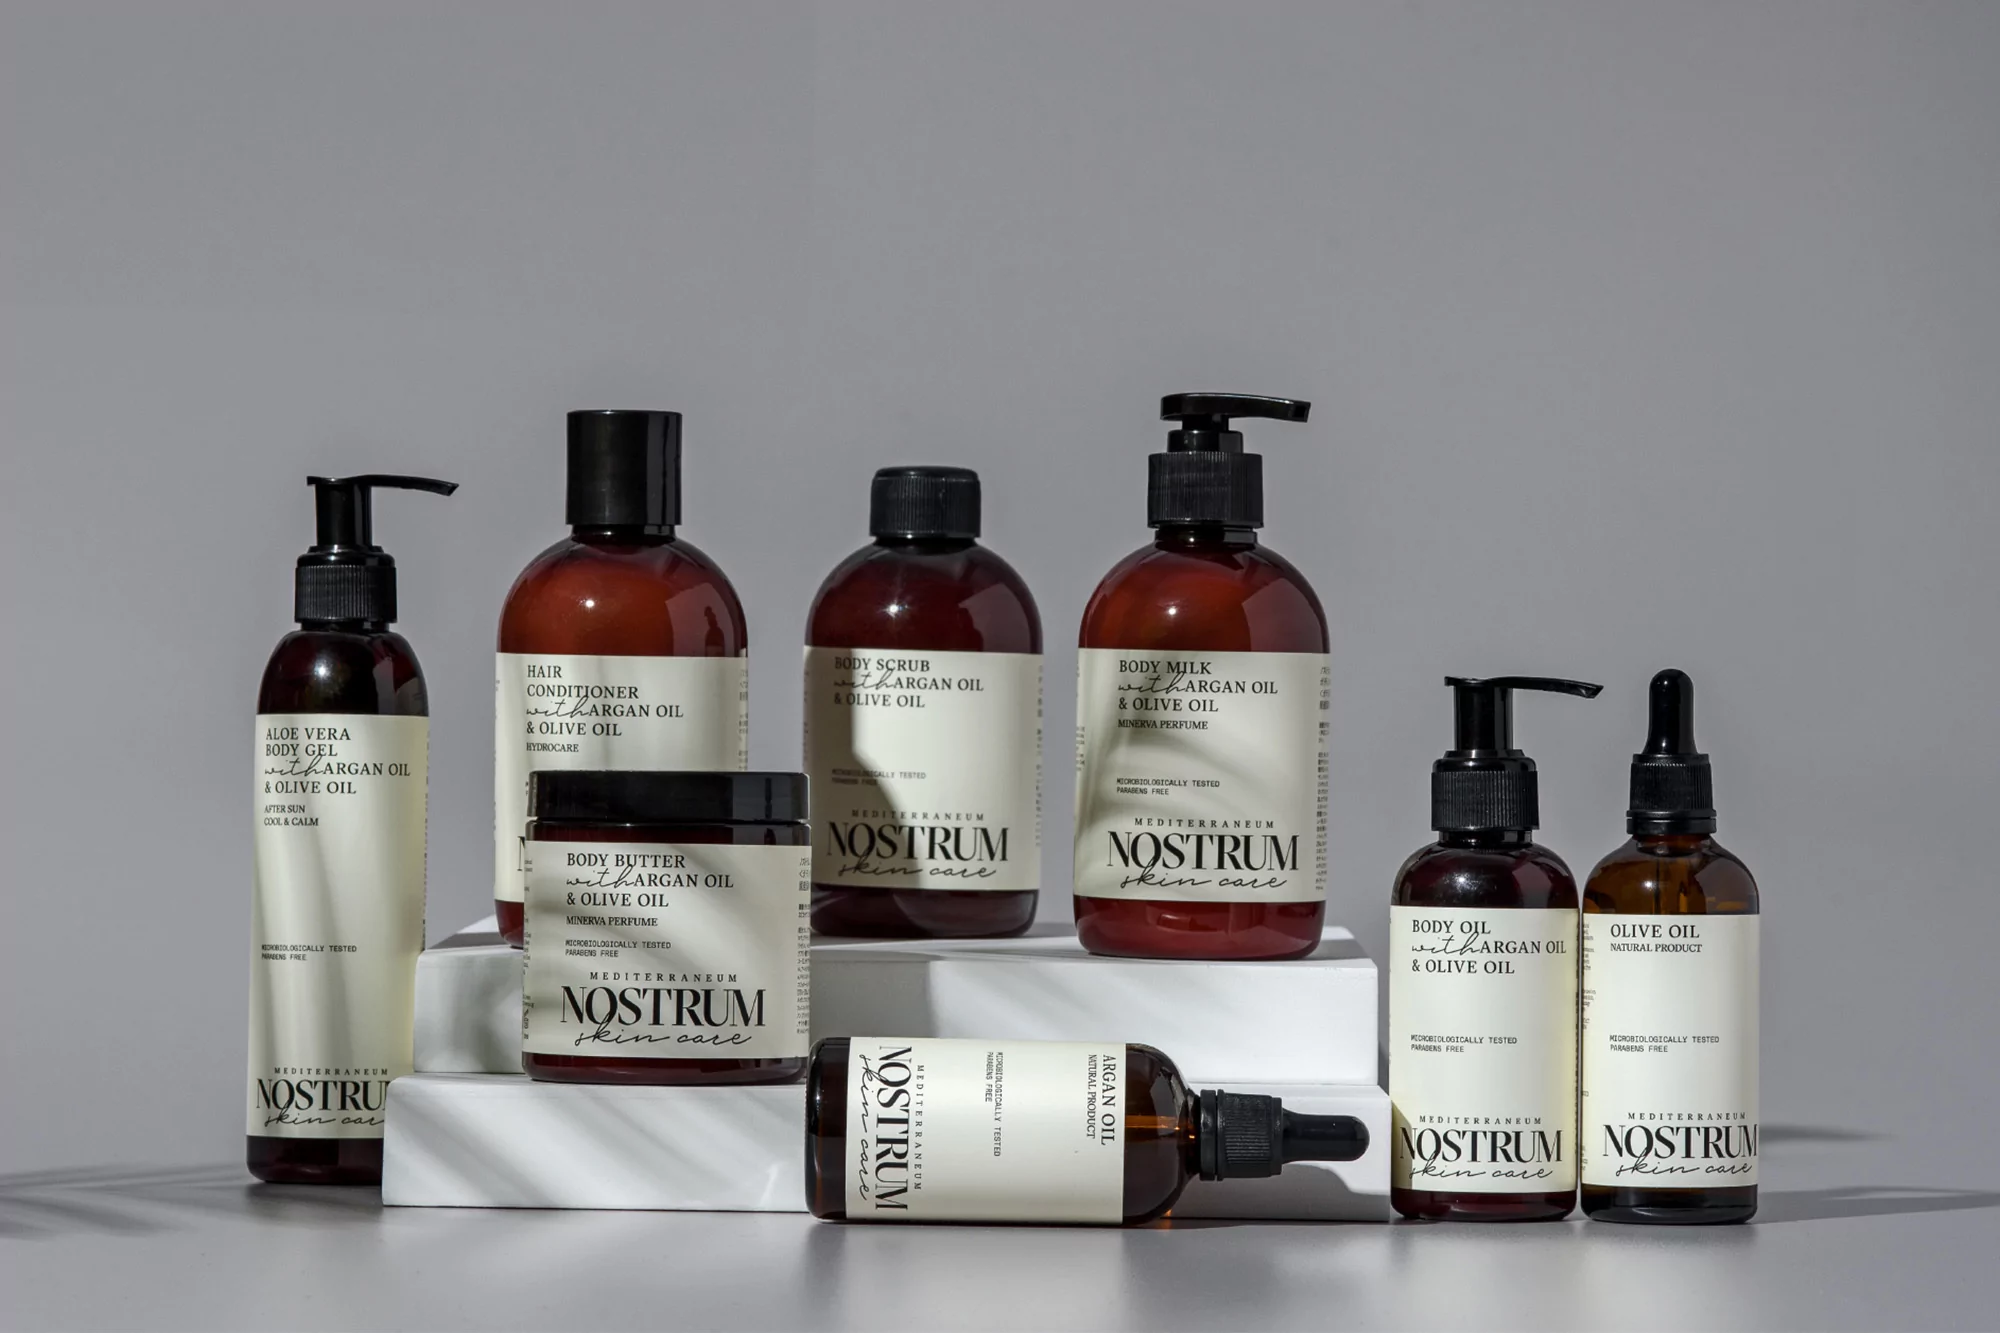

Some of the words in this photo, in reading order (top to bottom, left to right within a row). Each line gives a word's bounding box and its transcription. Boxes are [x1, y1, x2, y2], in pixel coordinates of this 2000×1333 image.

[527, 665, 562, 679] HAIR
[834, 657, 871, 670] BODY
[876, 659, 930, 672] SCRUB
[1119, 660, 1161, 674] BODY
[1167, 662, 1212, 675] MILK
[834, 669, 895, 690] with
[894, 677, 952, 690] ARGAN
[958, 679, 984, 691] OIL
[1118, 671, 1186, 694] with
[1185, 680, 1246, 693] ARGAN
[1251, 681, 1278, 694] OIL
[527, 684, 639, 699] CONDITIONER
[526, 696, 589, 718] with
[588, 704, 650, 717] ARGAN
[656, 705, 683, 718] OIL
[834, 694, 841, 705] &
[846, 693, 891, 706] OLIVE
[897, 695, 925, 708] OIL
[1119, 698, 1127, 710] &
[1133, 698, 1182, 711] OLIVE
[1189, 699, 1218, 712] OIL
[527, 722, 535, 734] &
[539, 722, 586, 735] OLIVE
[592, 723, 622, 737] OIL
[1118, 719, 1158, 729] MINERVA
[1160, 720, 1208, 730] PERFUME
[266, 728, 299, 740] ALOE
[304, 728, 351, 741] VERA
[265, 744, 299, 756] BODY
[305, 744, 338, 757] GEL
[526, 743, 579, 753] HYDROCARE
[265, 755, 323, 777] with
[323, 763, 383, 776] ARGAN
[388, 763, 410, 776] OIL
[265, 781, 271, 793] &
[275, 781, 320, 793] OLIVE
[327, 781, 356, 794] OIL
[1116, 778, 1187, 787] MICROBIOLOGICALLY
[264, 805, 286, 813] AFTER
[287, 805, 306, 814] SUN
[851, 809, 984, 821] MEDITERRANEUM
[264, 817, 282, 826] COOL
[284, 818, 290, 826] &
[292, 818, 319, 826] CALM
[1134, 818, 1275, 829] MEDITERRANEUM
[827, 822, 1009, 861] NOSTRUM
[1107, 831, 1299, 871] NOSTRUM
[567, 853, 609, 866] BODY
[615, 854, 685, 868] BUTTER
[838, 853, 923, 876] skin
[929, 867, 997, 878] care
[566, 864, 635, 888] with
[634, 873, 698, 888] ARGAN
[704, 874, 734, 888] OIL
[1120, 857, 1212, 888] skin
[1218, 877, 1287, 888] care
[567, 893, 576, 906] &
[580, 892, 632, 907] OLIVE
[637, 893, 669, 907] OIL
[566, 915, 606, 926] MINERVA
[608, 916, 658, 927] PERFUME
[1412, 920, 1454, 933] BODY
[1460, 921, 1491, 934] OIL
[1610, 924, 1662, 938] OLIVE
[1668, 925, 1700, 938] OIL
[329, 945, 357, 953] TESTED
[565, 939, 638, 949] MICROBIOLOGICALLY
[642, 941, 671, 949] TESTED
[1412, 931, 1481, 955] with
[1480, 941, 1541, 954] ARGAN
[1546, 941, 1566, 953] OIL
[1610, 943, 1652, 952] NATURAL
[1655, 944, 1702, 952] PRODUCT
[601, 950, 619, 958] FREE
[1412, 959, 1420, 972] &
[1426, 960, 1477, 973] OLIVE
[1484, 961, 1515, 974] OIL
[590, 971, 738, 982] MEDITERRANEUM
[560, 985, 766, 1027] NOSTRUM
[574, 1012, 670, 1046] skin
[677, 1033, 752, 1045] care
[1411, 1034, 1484, 1043] MICROBIOLOGICALLY
[1609, 1035, 1688, 1043] MICROBIOLOGICALLY
[1411, 1044, 1442, 1052] PARABENS
[1610, 1044, 1644, 1052] PARABENS
[274, 1067, 388, 1075] MEDITERRANEUM
[985, 1051, 994, 1080] PARABENS
[1087, 1054, 1097, 1090] NATURAL
[994, 1051, 1004, 1122] MICROBIOLOGICALLY
[1101, 1054, 1117, 1107] ARGAN
[256, 1078, 393, 1110] NOSTRU
[859, 1054, 889, 1133] skin
[985, 1084, 993, 1102] FREE
[264, 1102, 336, 1127] skin
[341, 1117, 385, 1126] car
[1086, 1091, 1096, 1139] PRODUCT
[1419, 1115, 1542, 1124] MEDITERRANEUM
[1628, 1112, 1746, 1121] MEDITERRANEUM
[874, 1045, 912, 1210] NOSTRUM
[914, 1064, 925, 1190] MEDITERRANEUM
[1101, 1113, 1116, 1146] OIL
[993, 1127, 1001, 1157] TESTED
[1400, 1127, 1562, 1163] NOSTRUM
[1602, 1124, 1758, 1159] NOSTRUM
[859, 1139, 870, 1200] care
[1409, 1152, 1486, 1179] skin
[1492, 1168, 1553, 1178] care
[1616, 1148, 1700, 1176] skin
[1705, 1163, 1752, 1174] care
